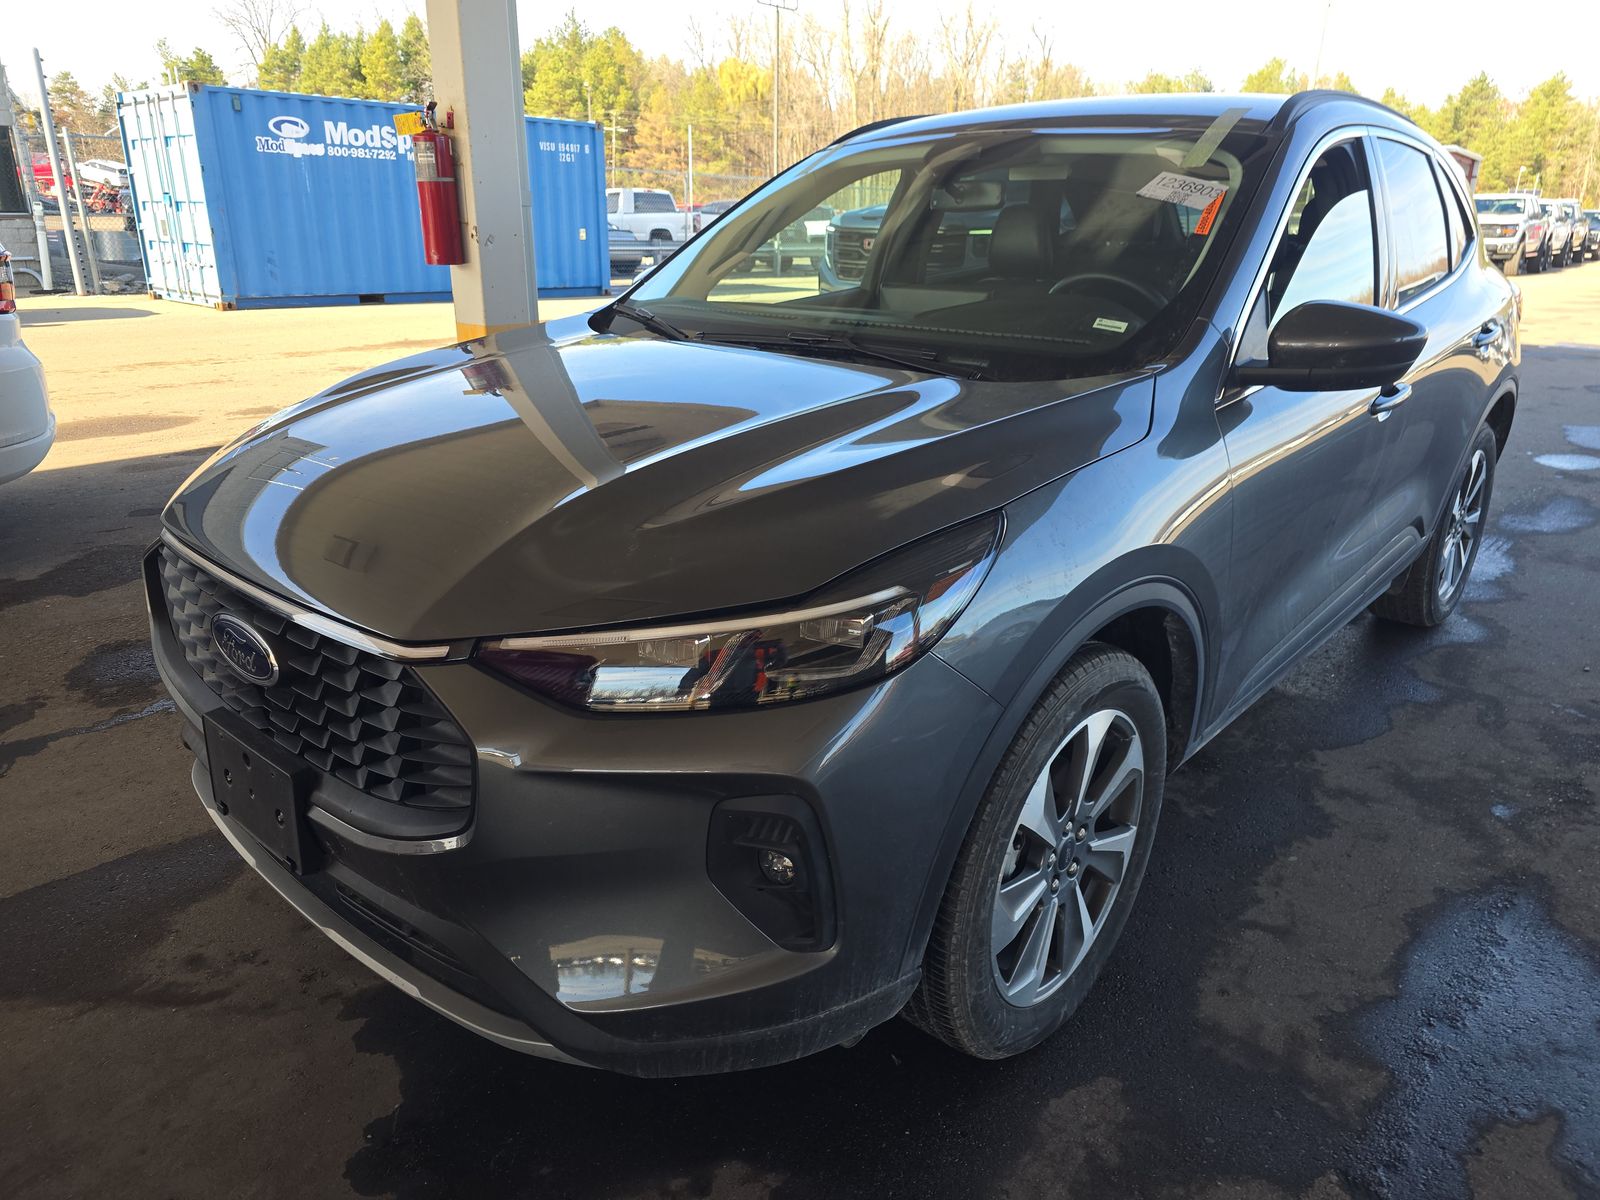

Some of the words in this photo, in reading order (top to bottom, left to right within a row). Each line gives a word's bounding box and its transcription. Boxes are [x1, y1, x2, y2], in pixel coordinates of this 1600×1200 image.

[323, 120, 414, 155] ModSp
[327, 145, 397, 160] 800-981-7292
[1156, 175, 1224, 199] 1236903
[221, 627, 257, 673] Ford
